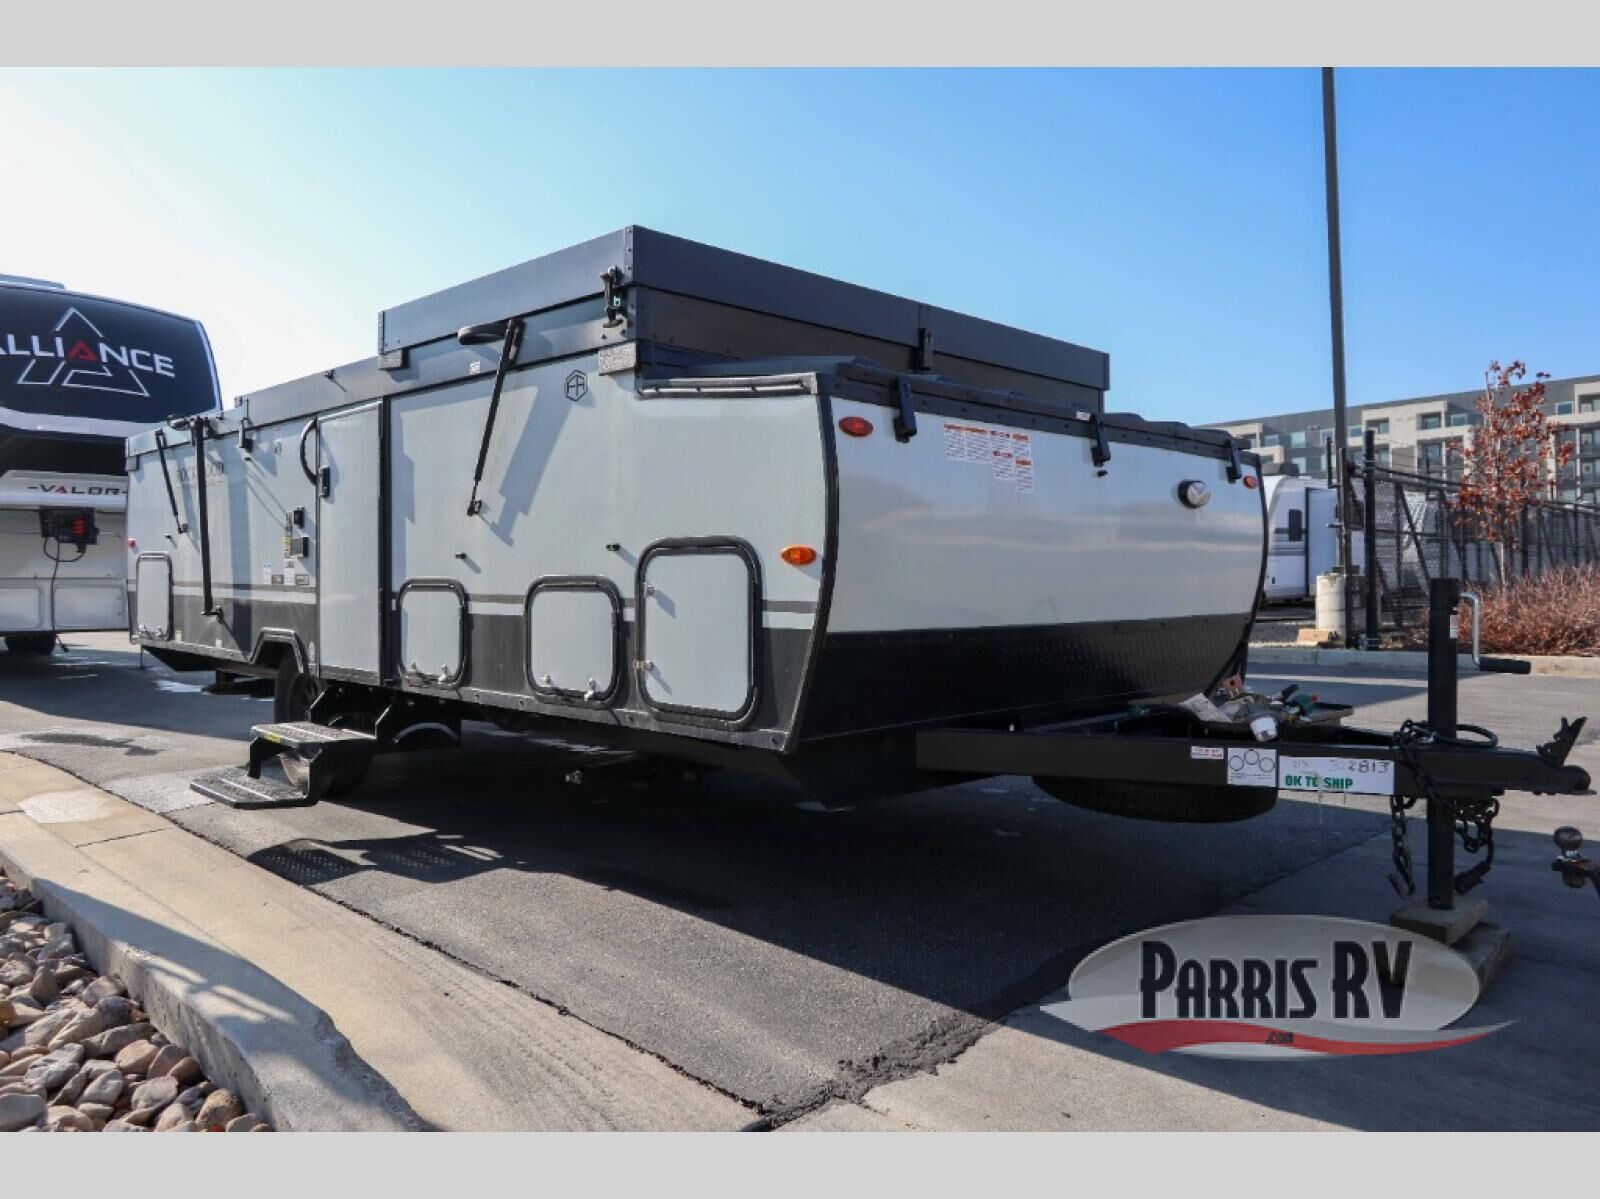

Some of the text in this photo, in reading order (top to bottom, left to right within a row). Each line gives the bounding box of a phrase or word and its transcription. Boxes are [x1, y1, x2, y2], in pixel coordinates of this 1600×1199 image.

[0, 333, 176, 379] LLIANCE
[1285, 774, 1302, 787] OK
[1323, 776, 1354, 790] SHIP
